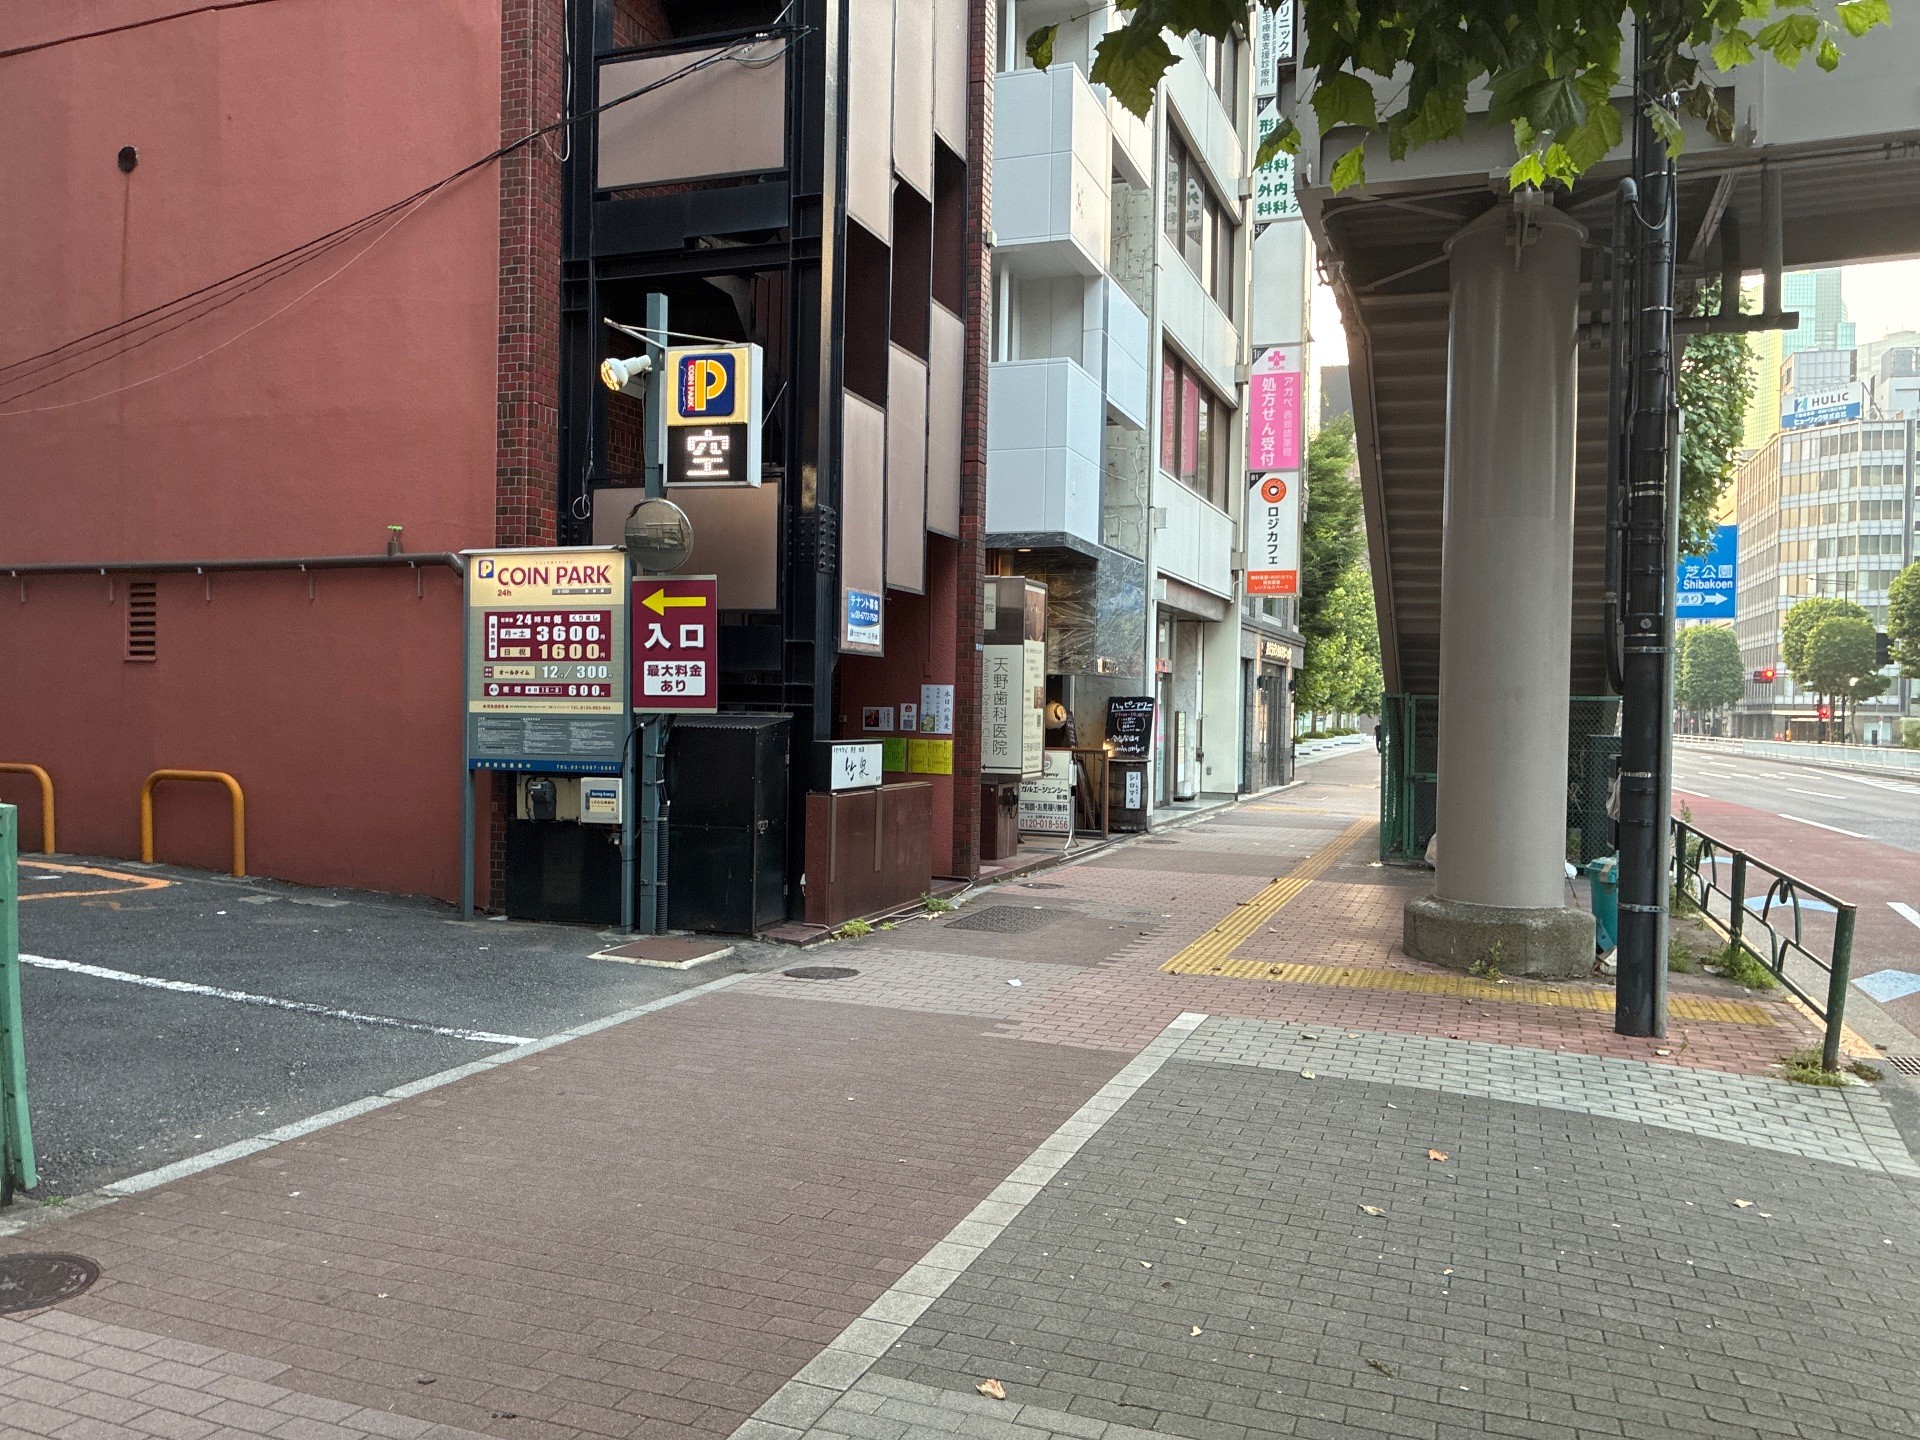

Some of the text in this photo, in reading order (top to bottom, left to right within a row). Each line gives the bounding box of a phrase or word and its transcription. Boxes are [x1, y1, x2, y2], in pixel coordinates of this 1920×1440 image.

[1259, 100, 1267, 109] 4F
[1255, 226, 1265, 234] 3F
[1253, 349, 1262, 360] 1F
[694, 359, 728, 412] P
[687, 386, 695, 408] PARK
[1811, 391, 1850, 407] HULIC
[1260, 377, 1277, 468] 処方せん受付
[687, 429, 730, 476] 空
[1267, 506, 1280, 565] ロジカフェ
[497, 564, 611, 586] COIN PARK
[1684, 564, 1733, 579] 芝公園
[1683, 579, 1733, 590] Shibakoen
[497, 589, 512, 597] 24h
[850, 594, 879, 611] テナント募集
[643, 622, 705, 650] 入口
[646, 663, 703, 678] 最大料金
[660, 679, 687, 693] あり
[981, 658, 991, 756] Amano Dental Clinic
[992, 657, 1009, 756] 天野歯科医院
[1020, 785, 1068, 794] ガルエージェンシー
[1019, 802, 1068, 813] ご相談・お見積り無料
[1020, 819, 1069, 830] 0120-018-556
